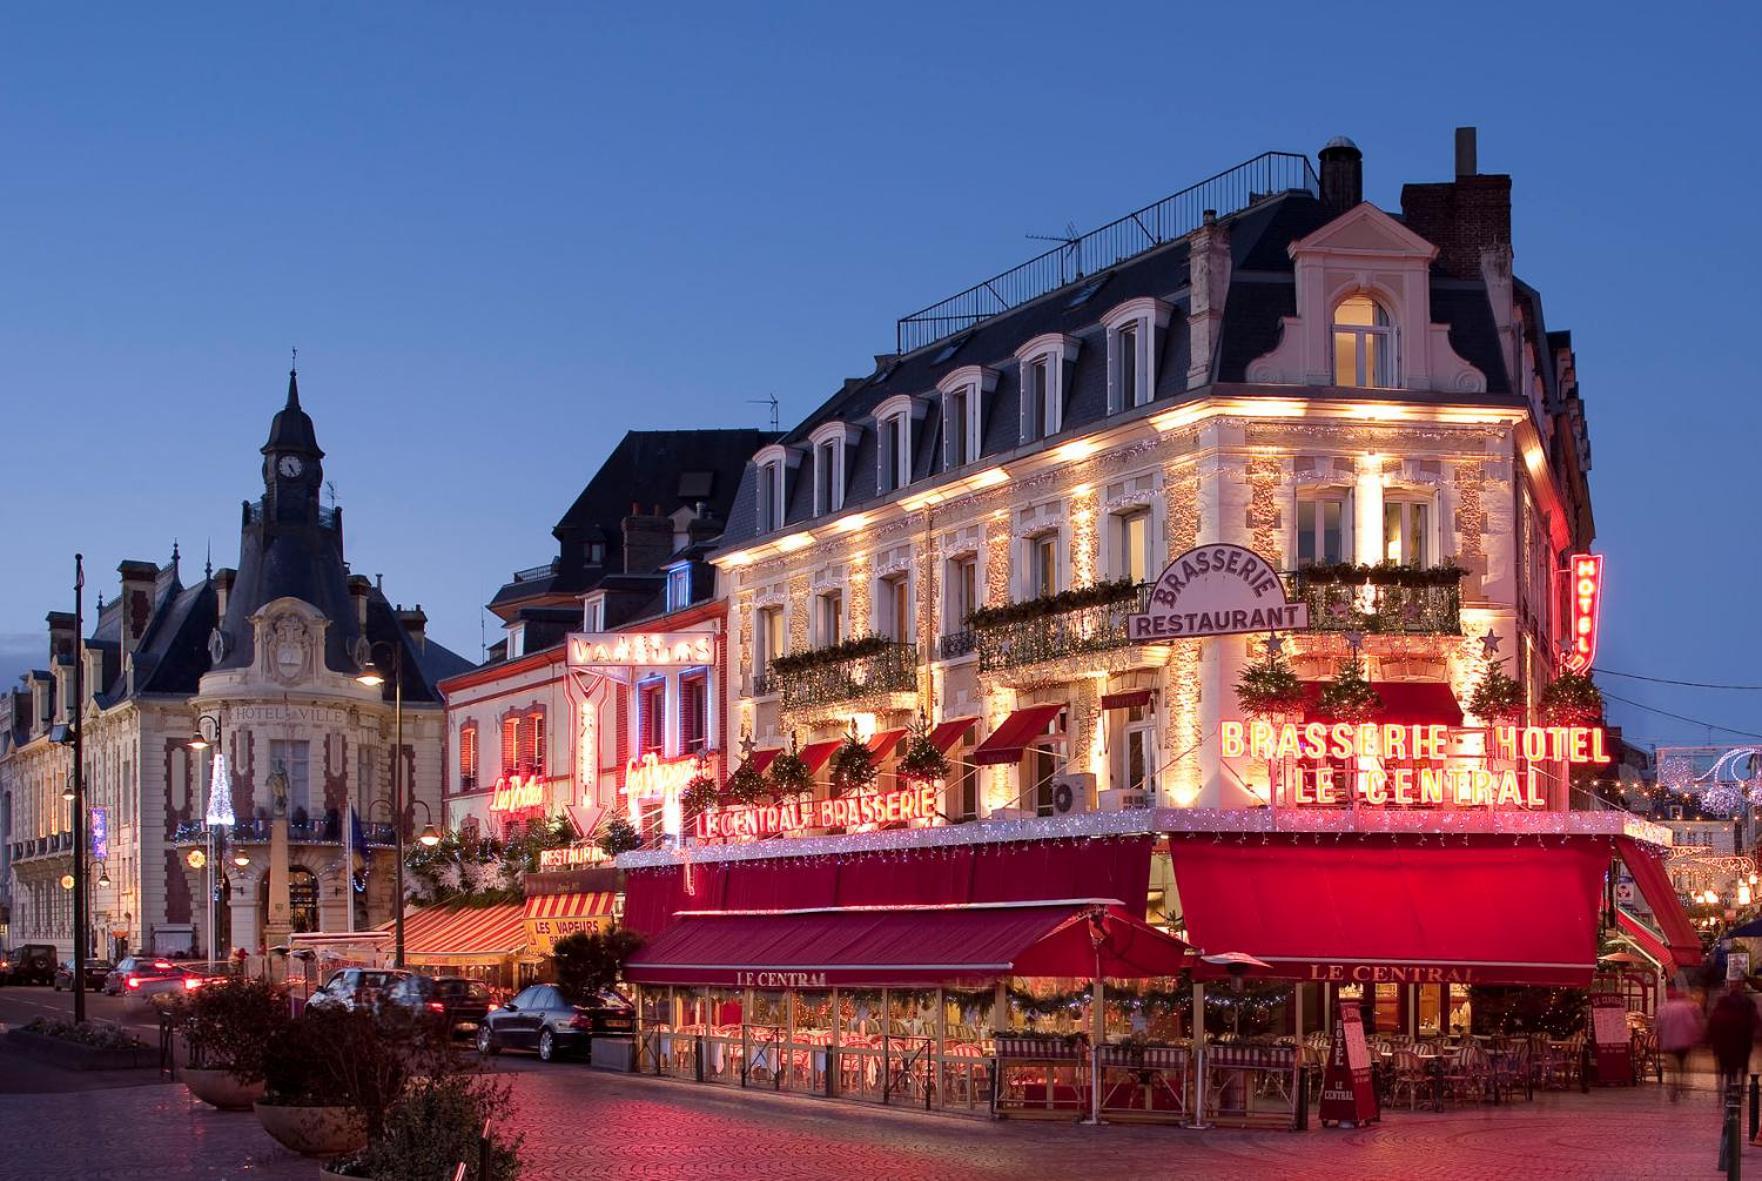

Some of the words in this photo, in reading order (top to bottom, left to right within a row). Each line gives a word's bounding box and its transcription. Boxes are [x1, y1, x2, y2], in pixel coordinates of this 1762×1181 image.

[1153, 549, 1277, 609] BRASSERIE
[1136, 606, 1299, 637] RESTAURANT
[1577, 561, 1595, 653] HOTEL
[298, 708, 342, 723] VILLE
[1220, 721, 1448, 760] BRASSERIE
[1499, 725, 1611, 763] HOTEL
[1295, 767, 1336, 804] LE
[1365, 768, 1545, 806] CENTRAL
[696, 811, 718, 839] LE
[721, 804, 804, 838] CENTRAL
[821, 789, 937, 828] BRASSERIE
[536, 921, 550, 934] LES
[556, 920, 599, 934] VAPEURS
[736, 971, 755, 986] LE
[1311, 964, 1344, 981] LE
[1334, 1020, 1344, 1066] HOTEL
[1324, 1091, 1354, 1101] CENTRAL
